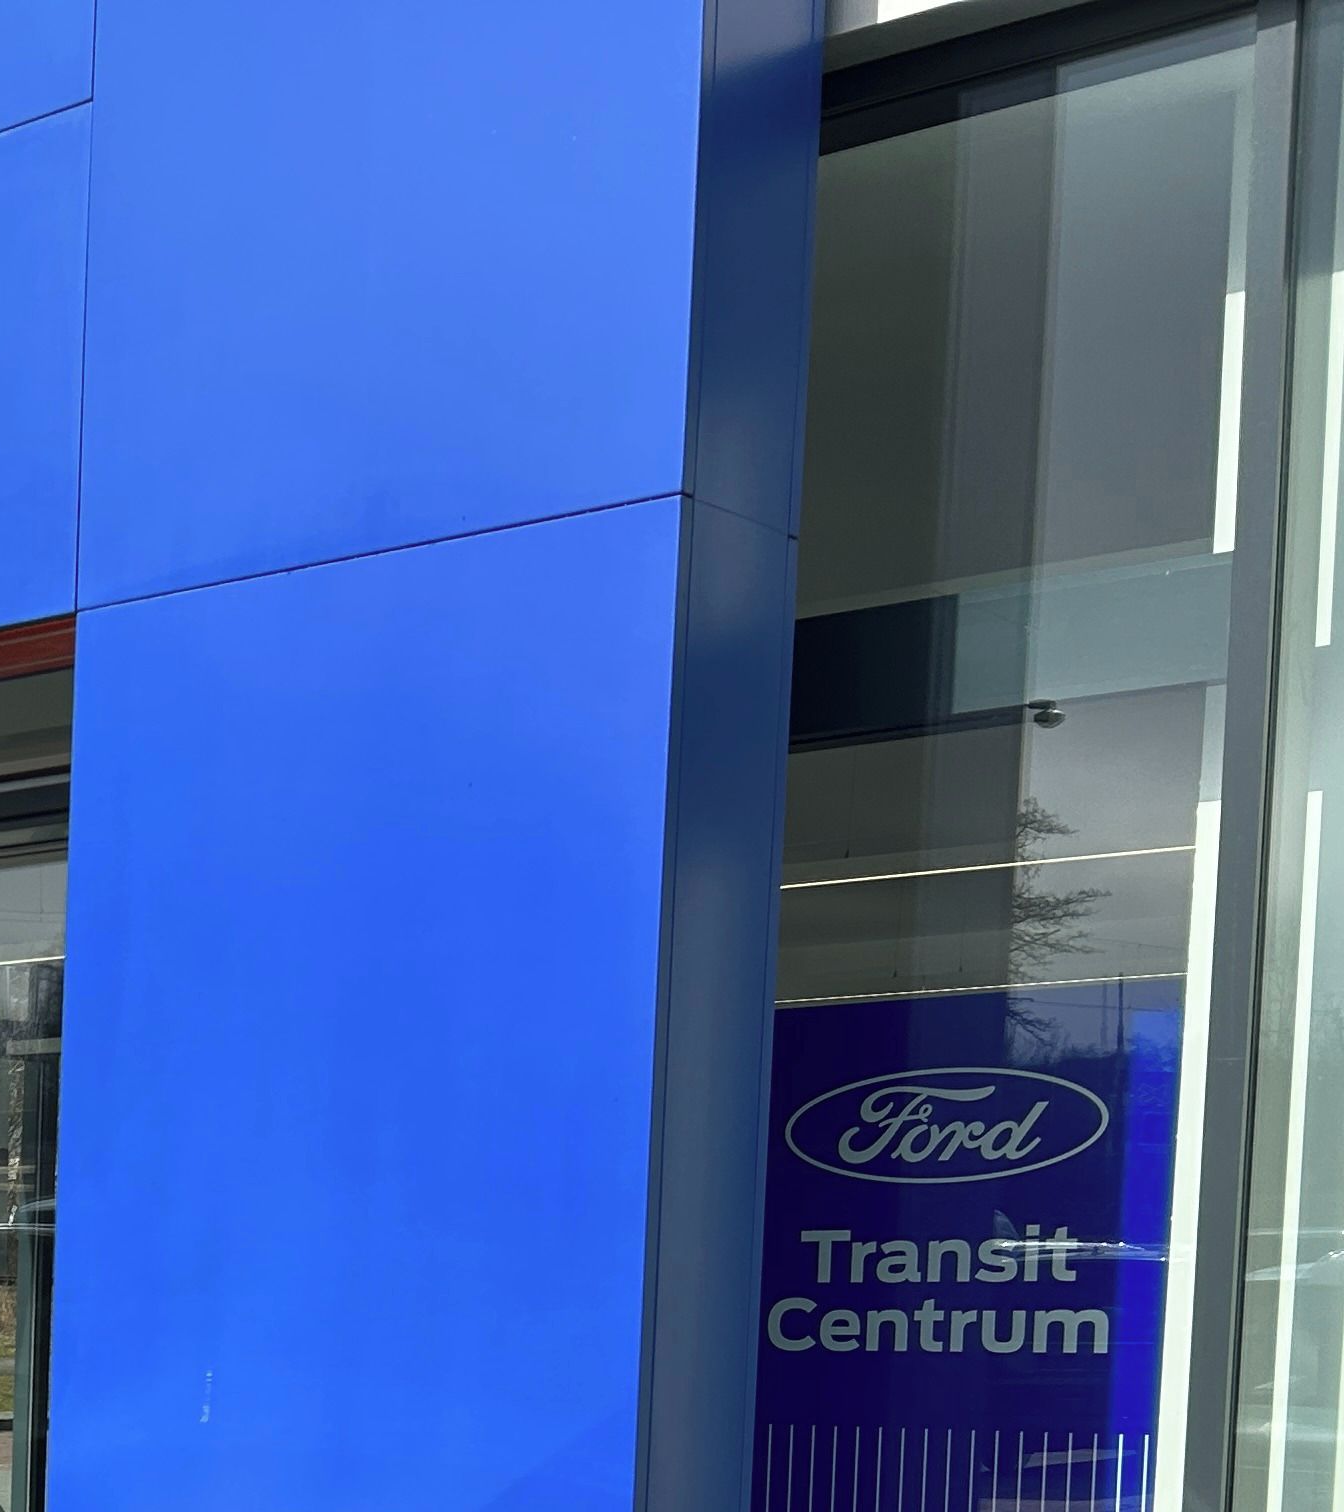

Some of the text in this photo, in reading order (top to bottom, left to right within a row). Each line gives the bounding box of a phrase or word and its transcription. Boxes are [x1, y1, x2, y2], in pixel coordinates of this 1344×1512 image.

[837, 1084, 1050, 1165] Ford
[800, 1224, 1079, 1284] Transit
[767, 1297, 1110, 1355] Centrum
